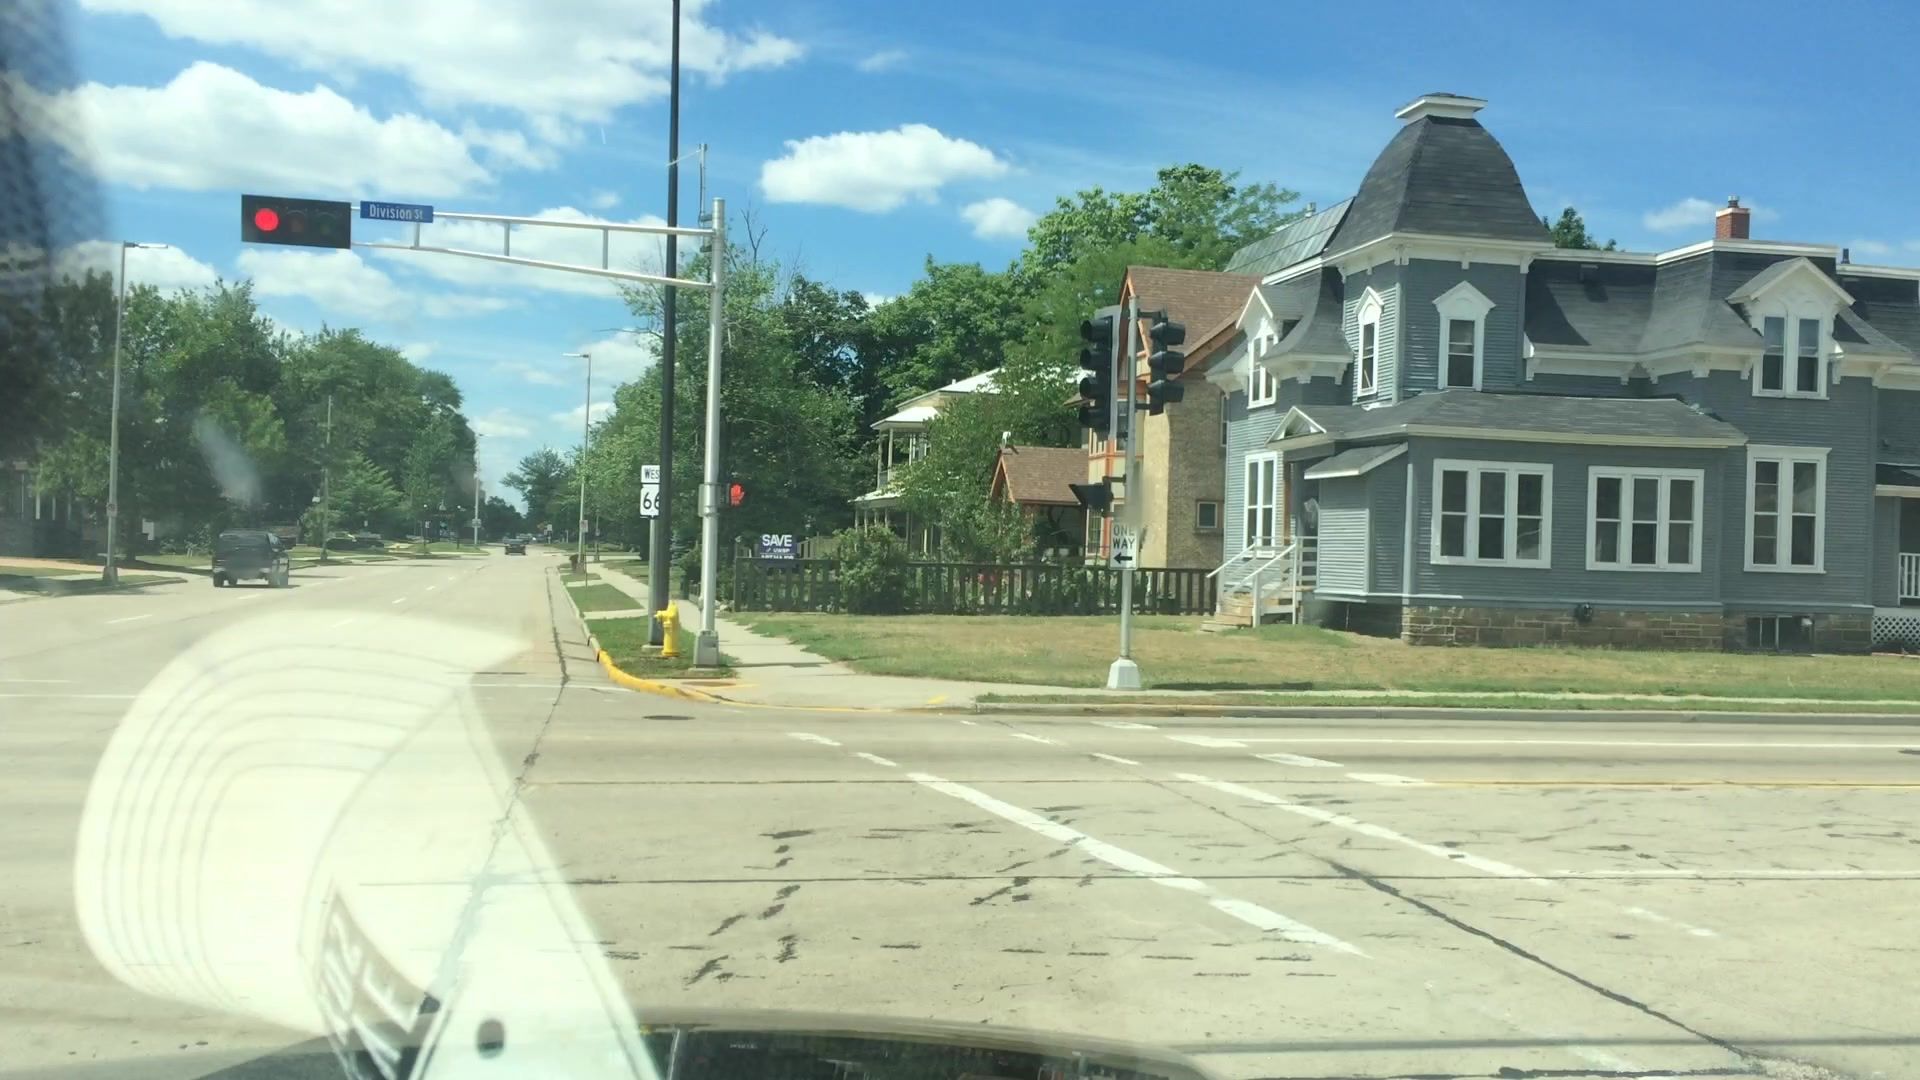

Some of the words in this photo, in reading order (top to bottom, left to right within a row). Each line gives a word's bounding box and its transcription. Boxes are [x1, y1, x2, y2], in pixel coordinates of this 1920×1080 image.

[369, 203, 412, 220] Division
[414, 208, 423, 220] St
[644, 468, 660, 480] WES
[643, 492, 660, 510] 66
[1113, 524, 1135, 536] ONE
[762, 533, 793, 547] SAVE
[1113, 537, 1136, 549] WAY
